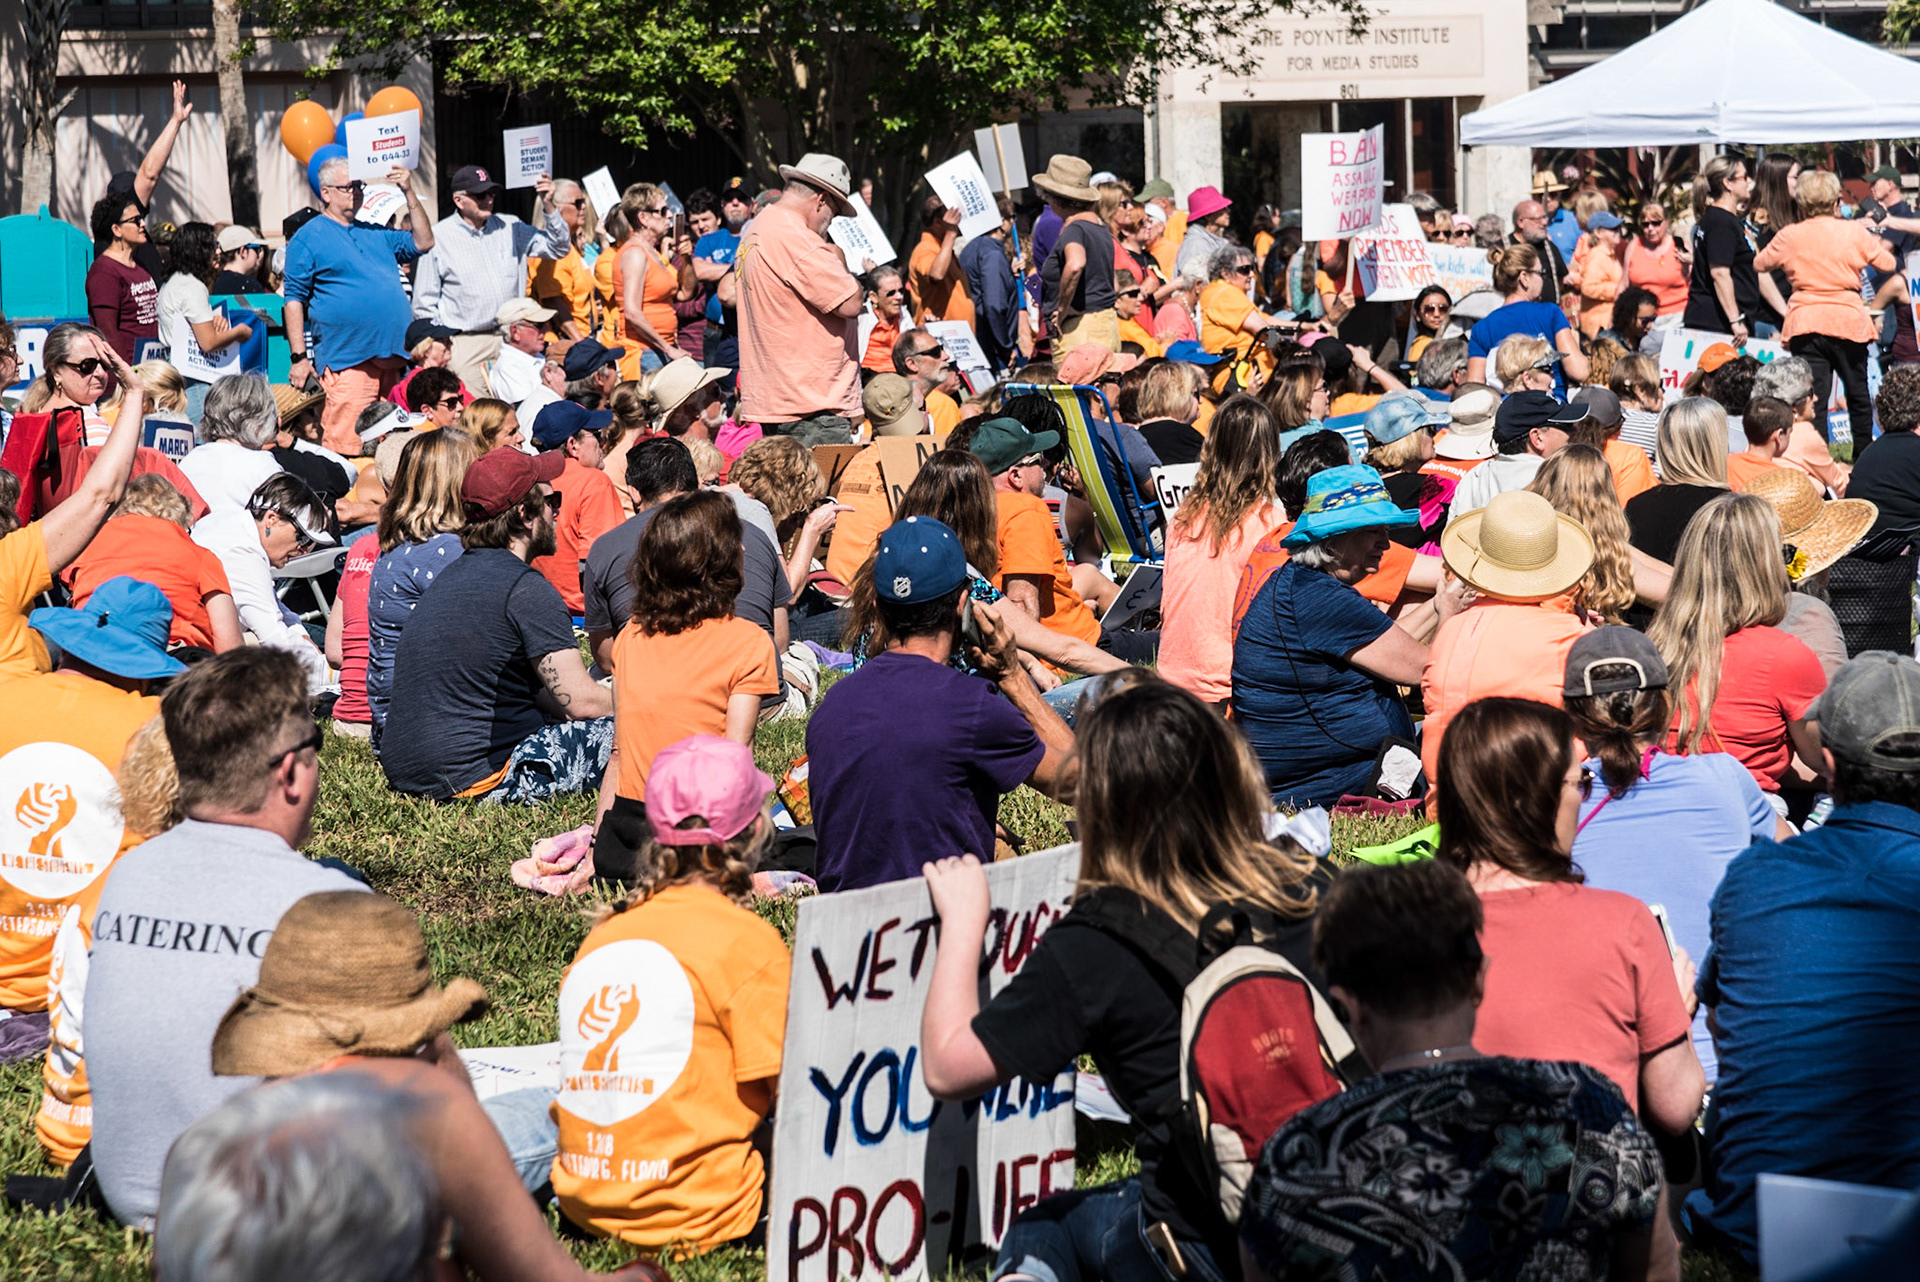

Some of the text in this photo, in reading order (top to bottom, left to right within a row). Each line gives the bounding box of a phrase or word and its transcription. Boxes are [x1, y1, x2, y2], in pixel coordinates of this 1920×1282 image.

[1374, 27, 1450, 45] INSTITUTE
[1287, 55, 1419, 71] FOR MEDIA STUDIES
[1340, 84, 1359, 99] 801
[378, 126, 399, 136] Text
[375, 138, 404, 149] Students
[520, 146, 548, 156] STUDENTS
[1330, 133, 1377, 165] BAN
[521, 155, 546, 164] DEMAND
[521, 163, 545, 172] ACTION
[1332, 167, 1376, 187] ASSAULT
[960, 180, 980, 215] DEMAND
[969, 181, 986, 212] ACTION
[1331, 186, 1377, 206] WEAPONS
[1339, 205, 1373, 231] NOW
[1354, 237, 1430, 263] REMEMBER
[1401, 264, 1437, 288] VOTE
[188, 356, 217, 370] ACTION
[159, 437, 189, 457] MARCH
[811, 917, 900, 1010] WE
